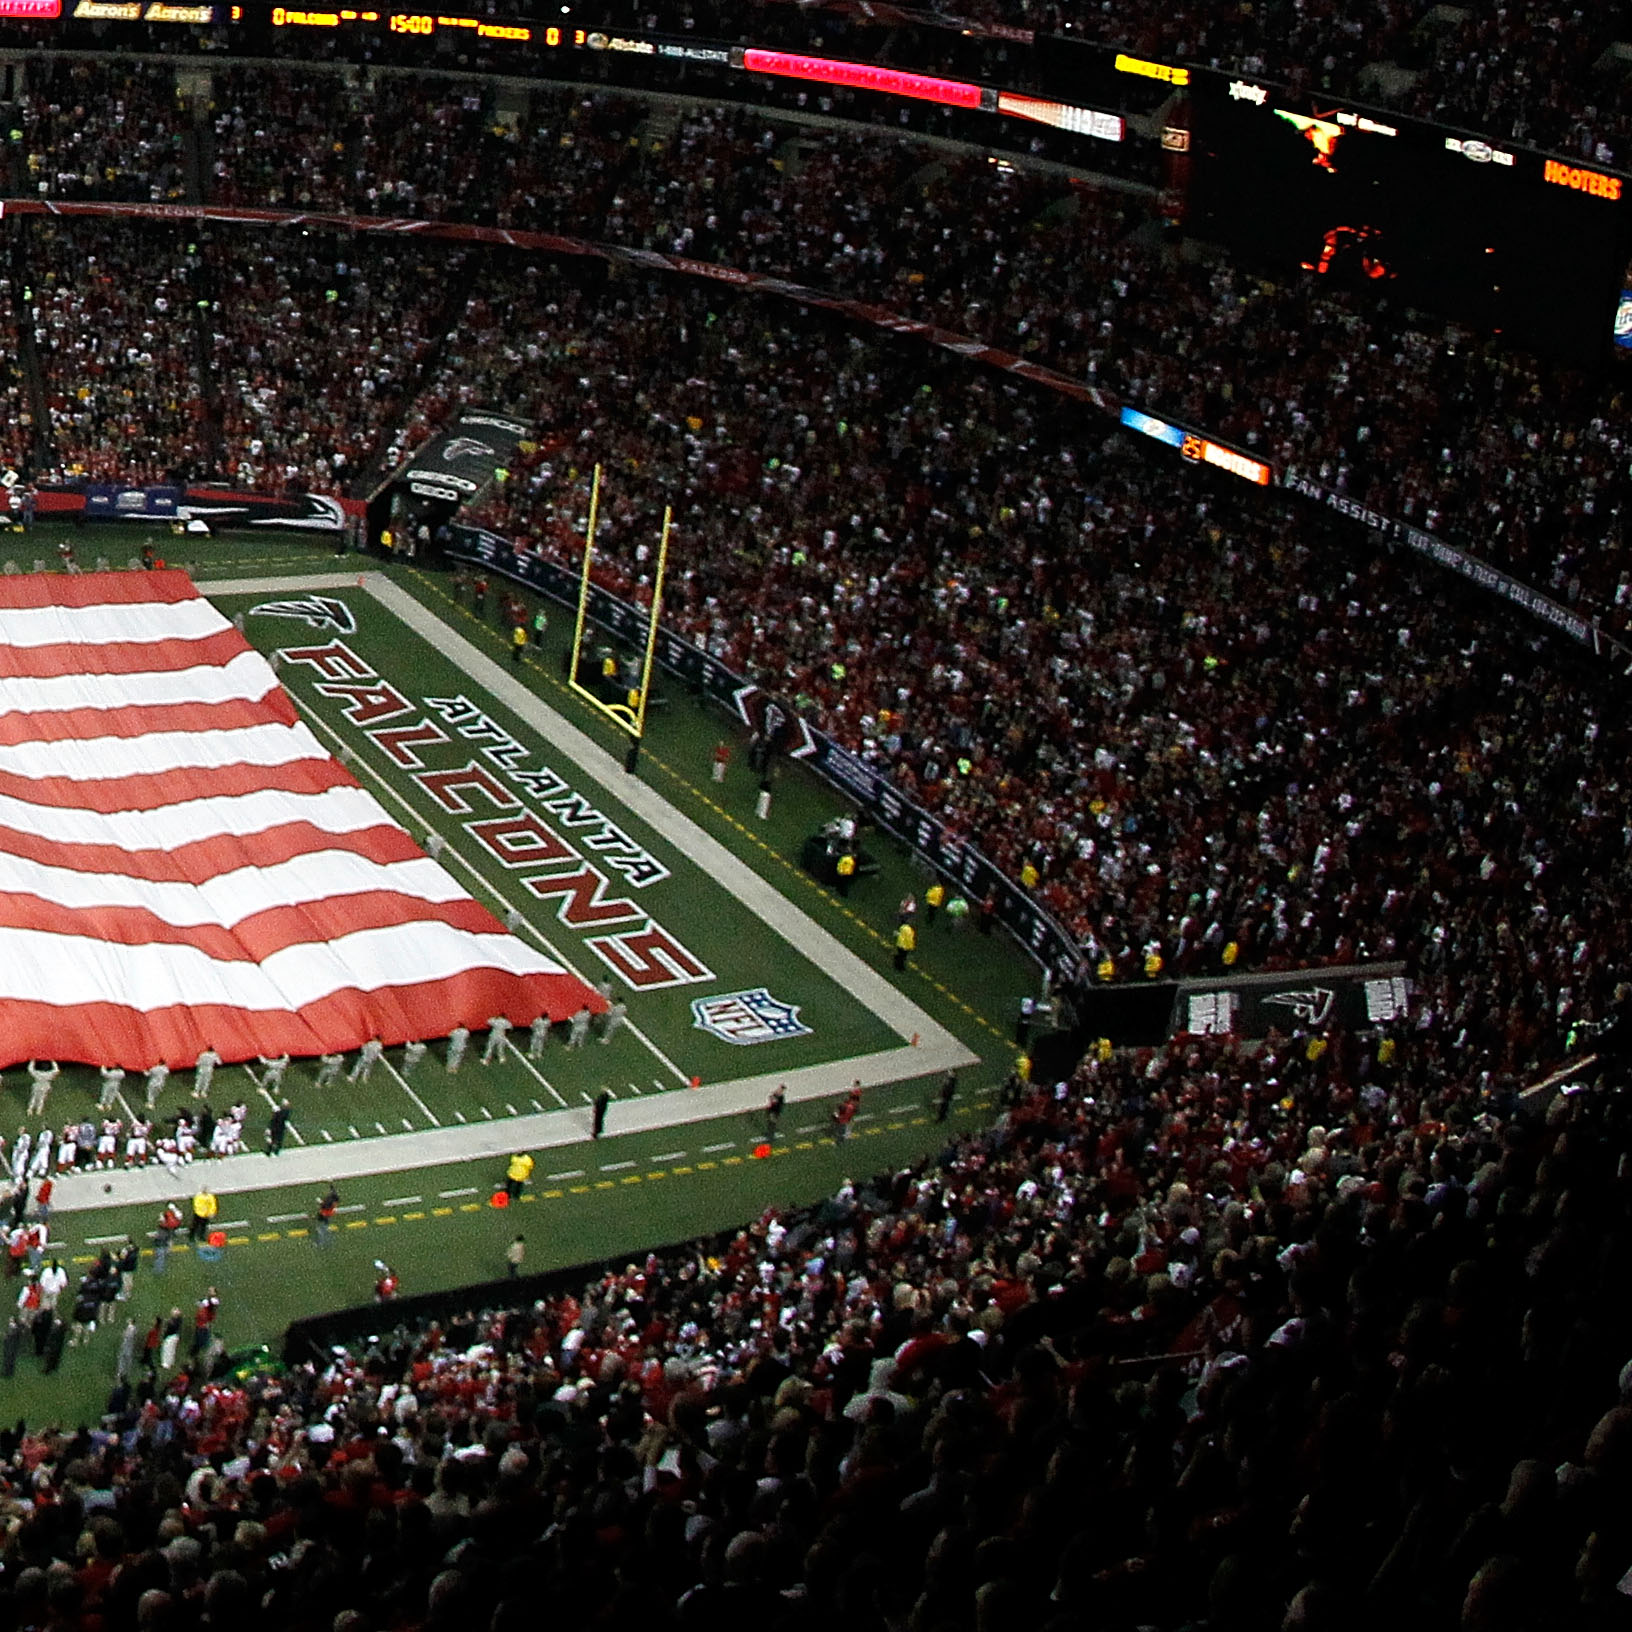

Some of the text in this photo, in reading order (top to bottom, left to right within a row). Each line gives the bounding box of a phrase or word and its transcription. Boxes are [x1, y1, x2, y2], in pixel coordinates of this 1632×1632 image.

[74, 0, 141, 20] Aaron's
[144, 2, 213, 23] Aaron's
[390, 14, 433, 35] 15:00
[1544, 159, 1623, 200] HOOTERS
[422, 694, 673, 889] ATLANTA
[277, 637, 717, 991] FALCONS
